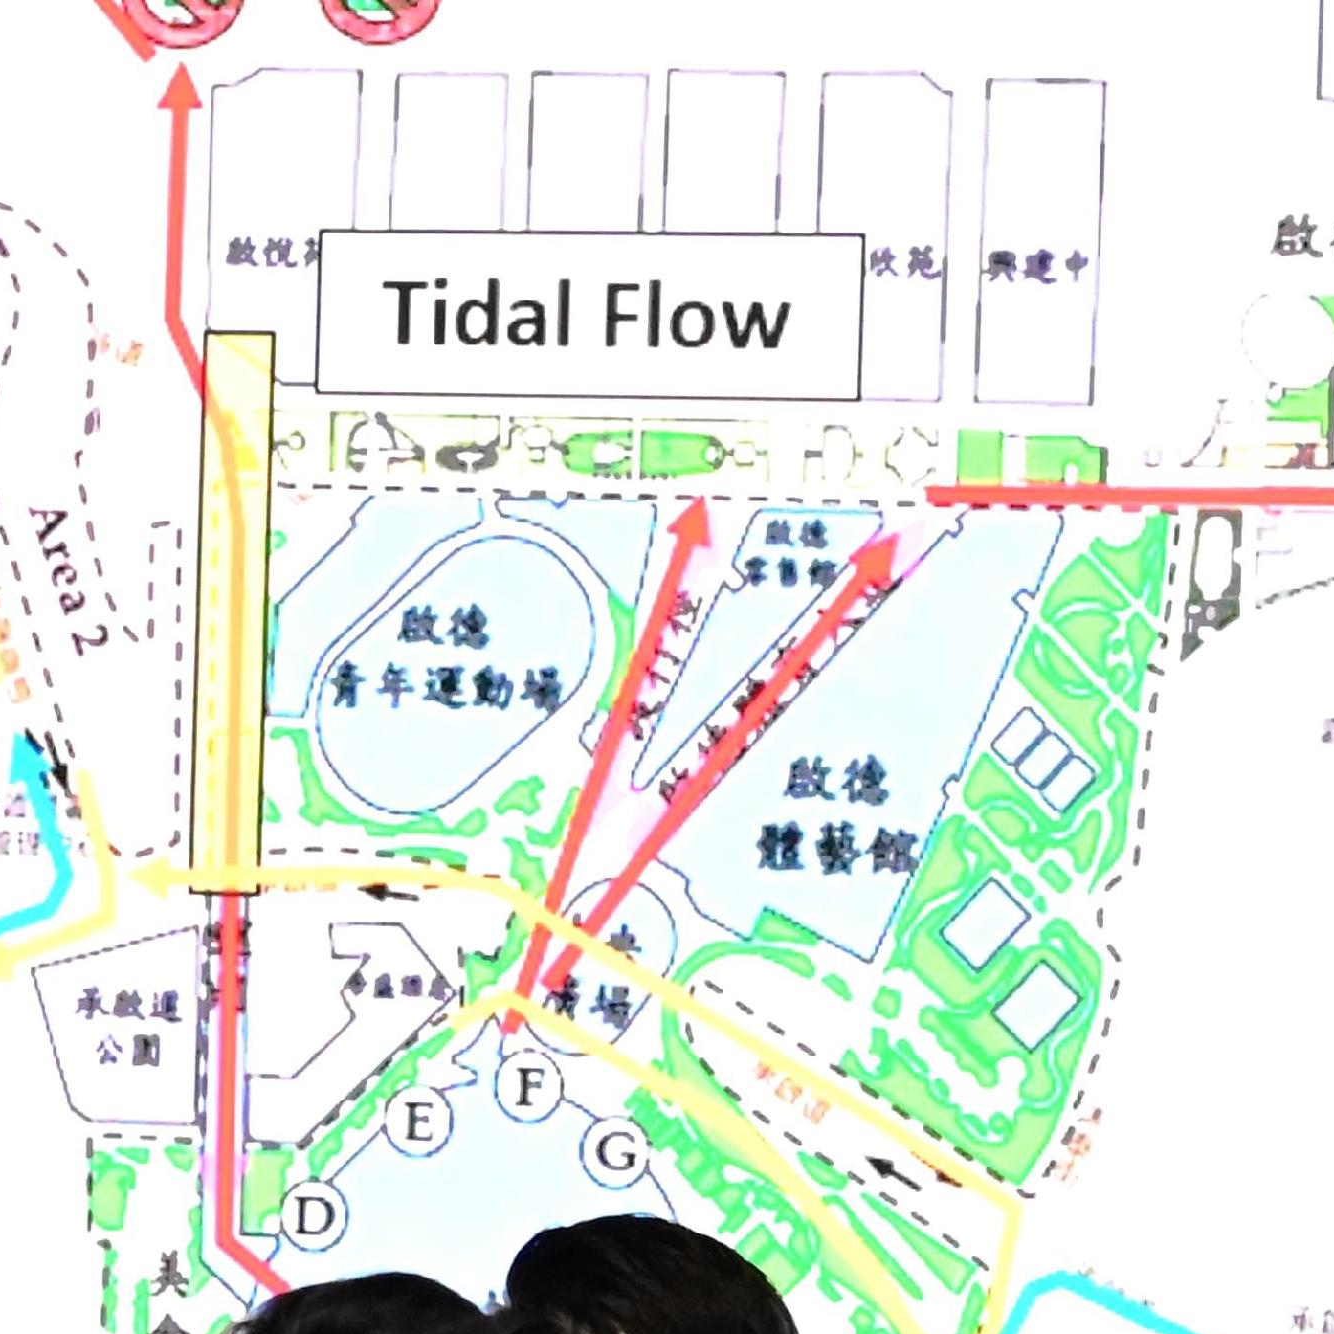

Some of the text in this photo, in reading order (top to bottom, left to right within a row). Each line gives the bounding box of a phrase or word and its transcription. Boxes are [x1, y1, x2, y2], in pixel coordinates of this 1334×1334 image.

[383, 278, 791, 349] Tidal Flow
[28, 505, 109, 657] Area 2
[398, 604, 489, 650] 啟德
[331, 661, 564, 710] 青年運動場
[782, 754, 890, 807] 啟德
[75, 988, 181, 1020] 承啟道
[517, 1069, 544, 1106] F
[404, 1103, 434, 1141] E
[596, 1133, 636, 1171] G
[295, 1194, 335, 1235] D
